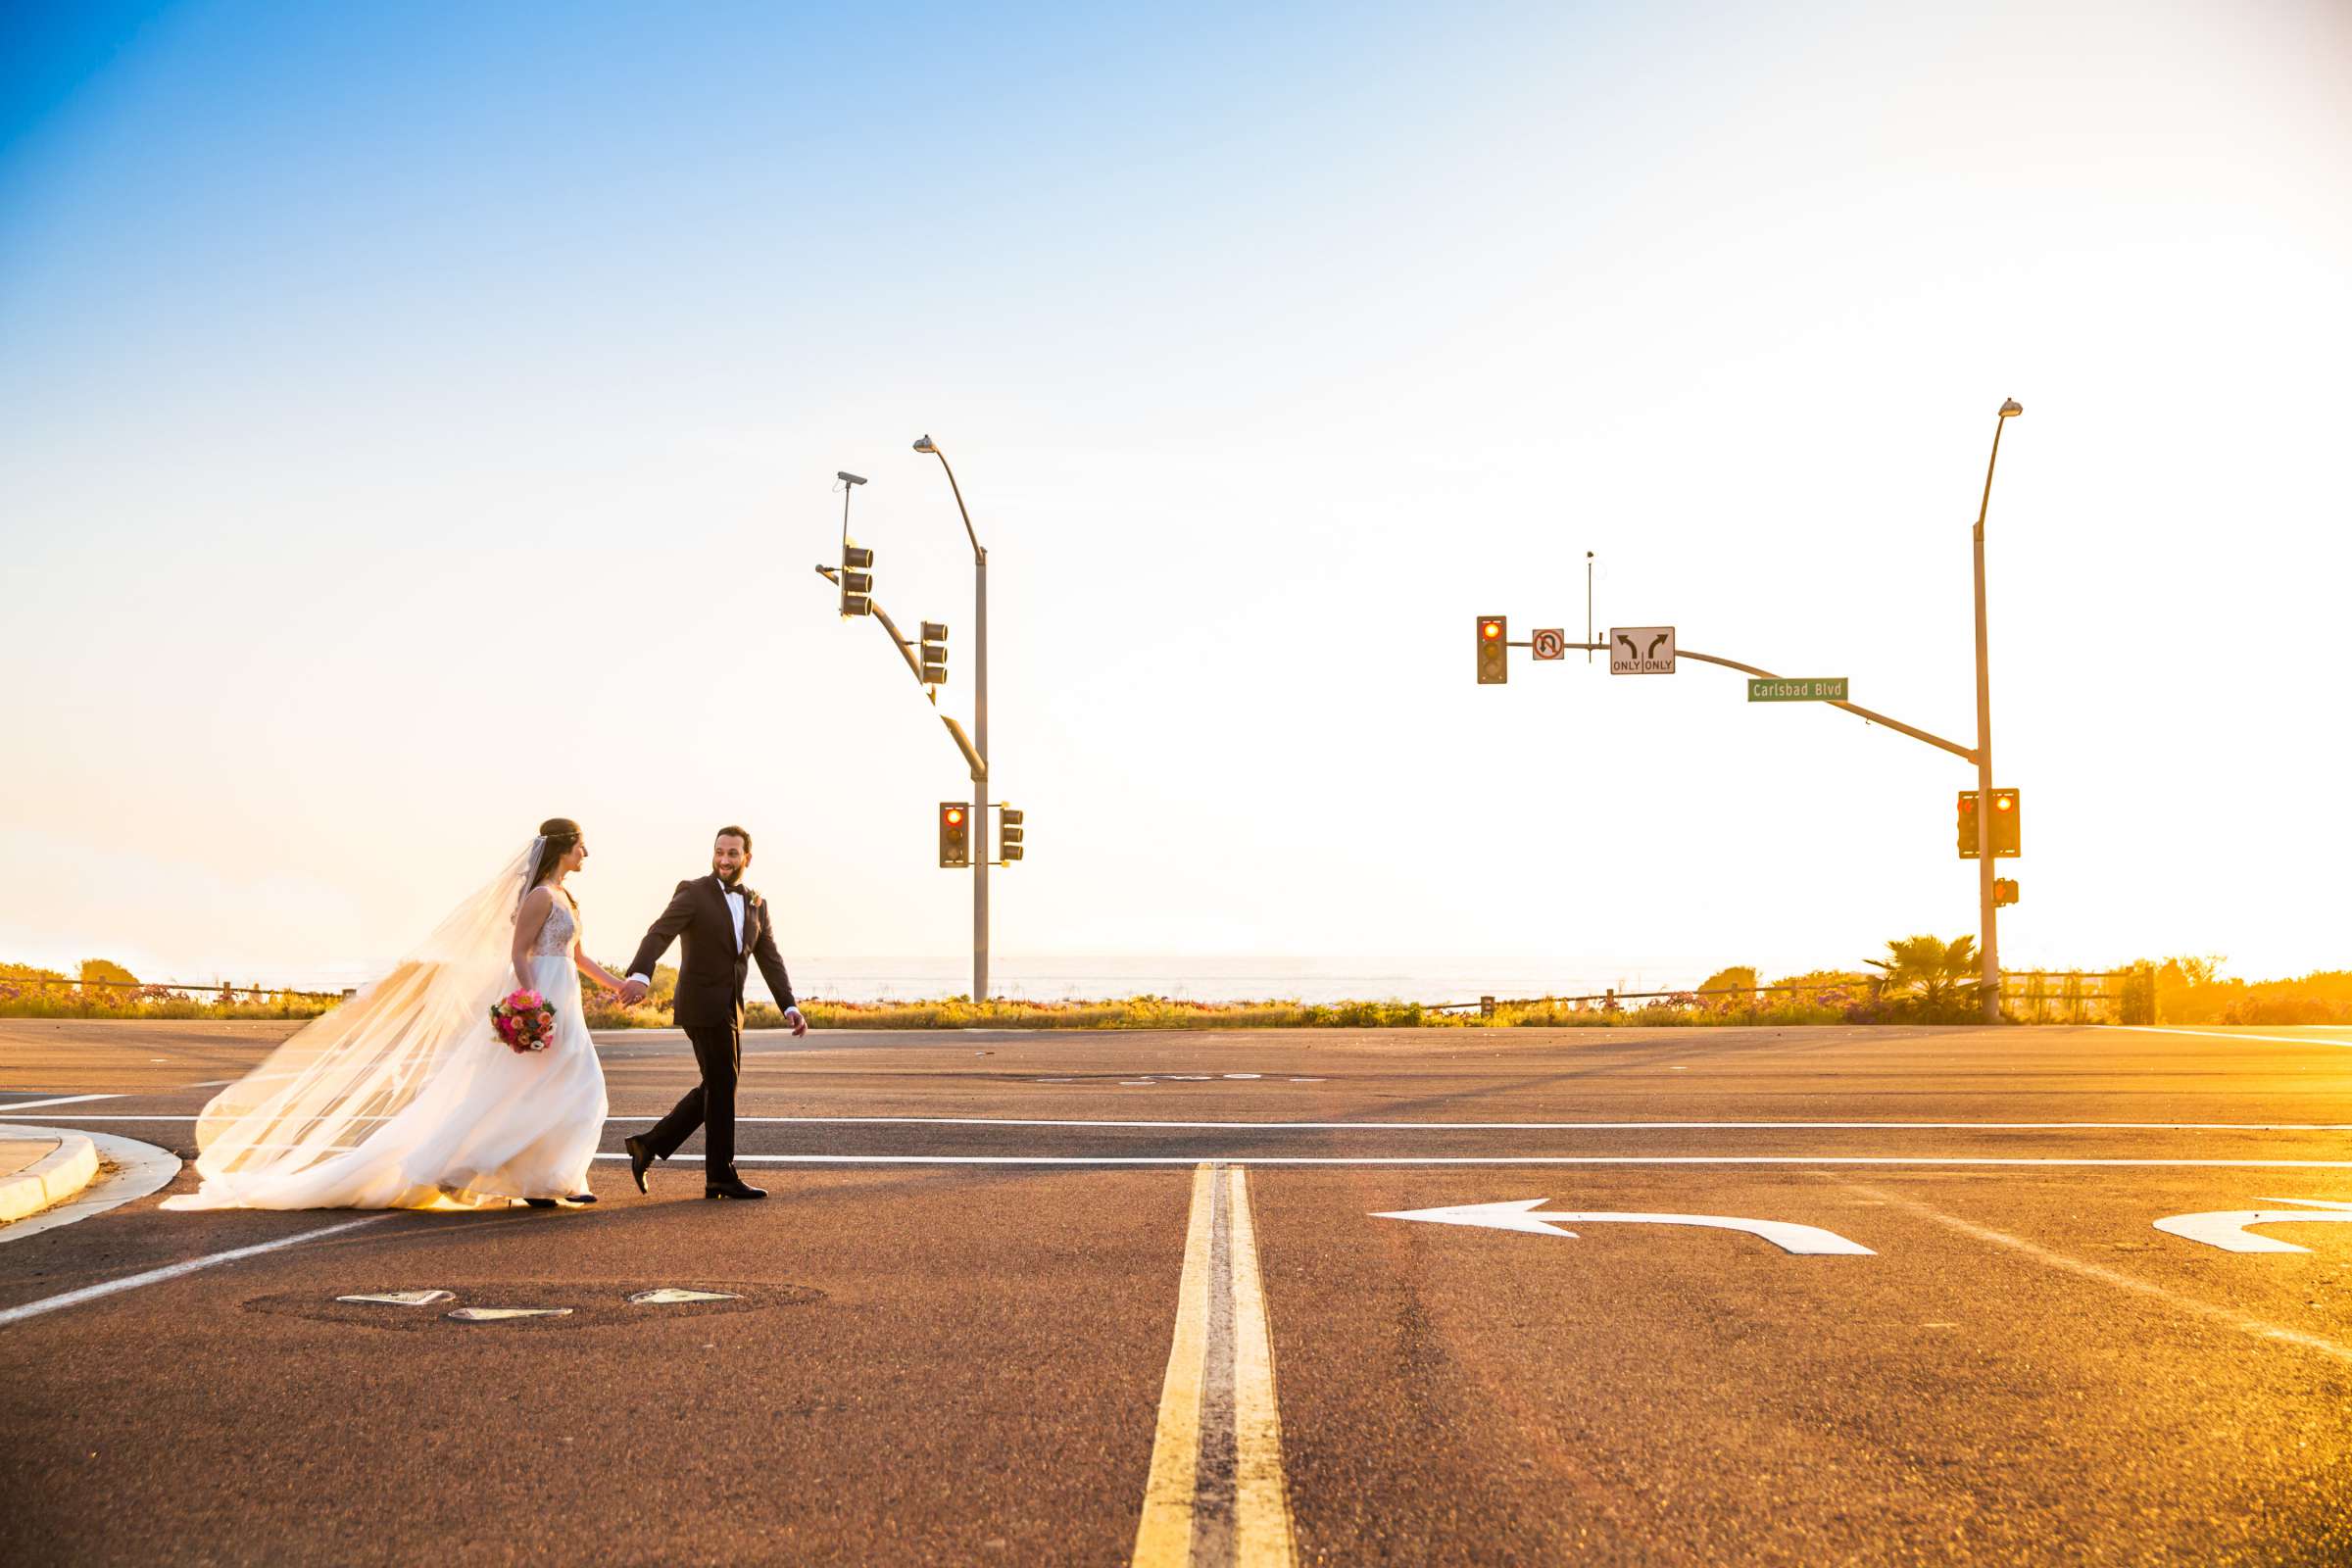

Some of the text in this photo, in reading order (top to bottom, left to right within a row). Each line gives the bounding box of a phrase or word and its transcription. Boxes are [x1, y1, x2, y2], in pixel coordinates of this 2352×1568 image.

[1613, 660, 1672, 671] ONLY ONLY
[1753, 682, 1841, 697] Carlsbad Blvd
